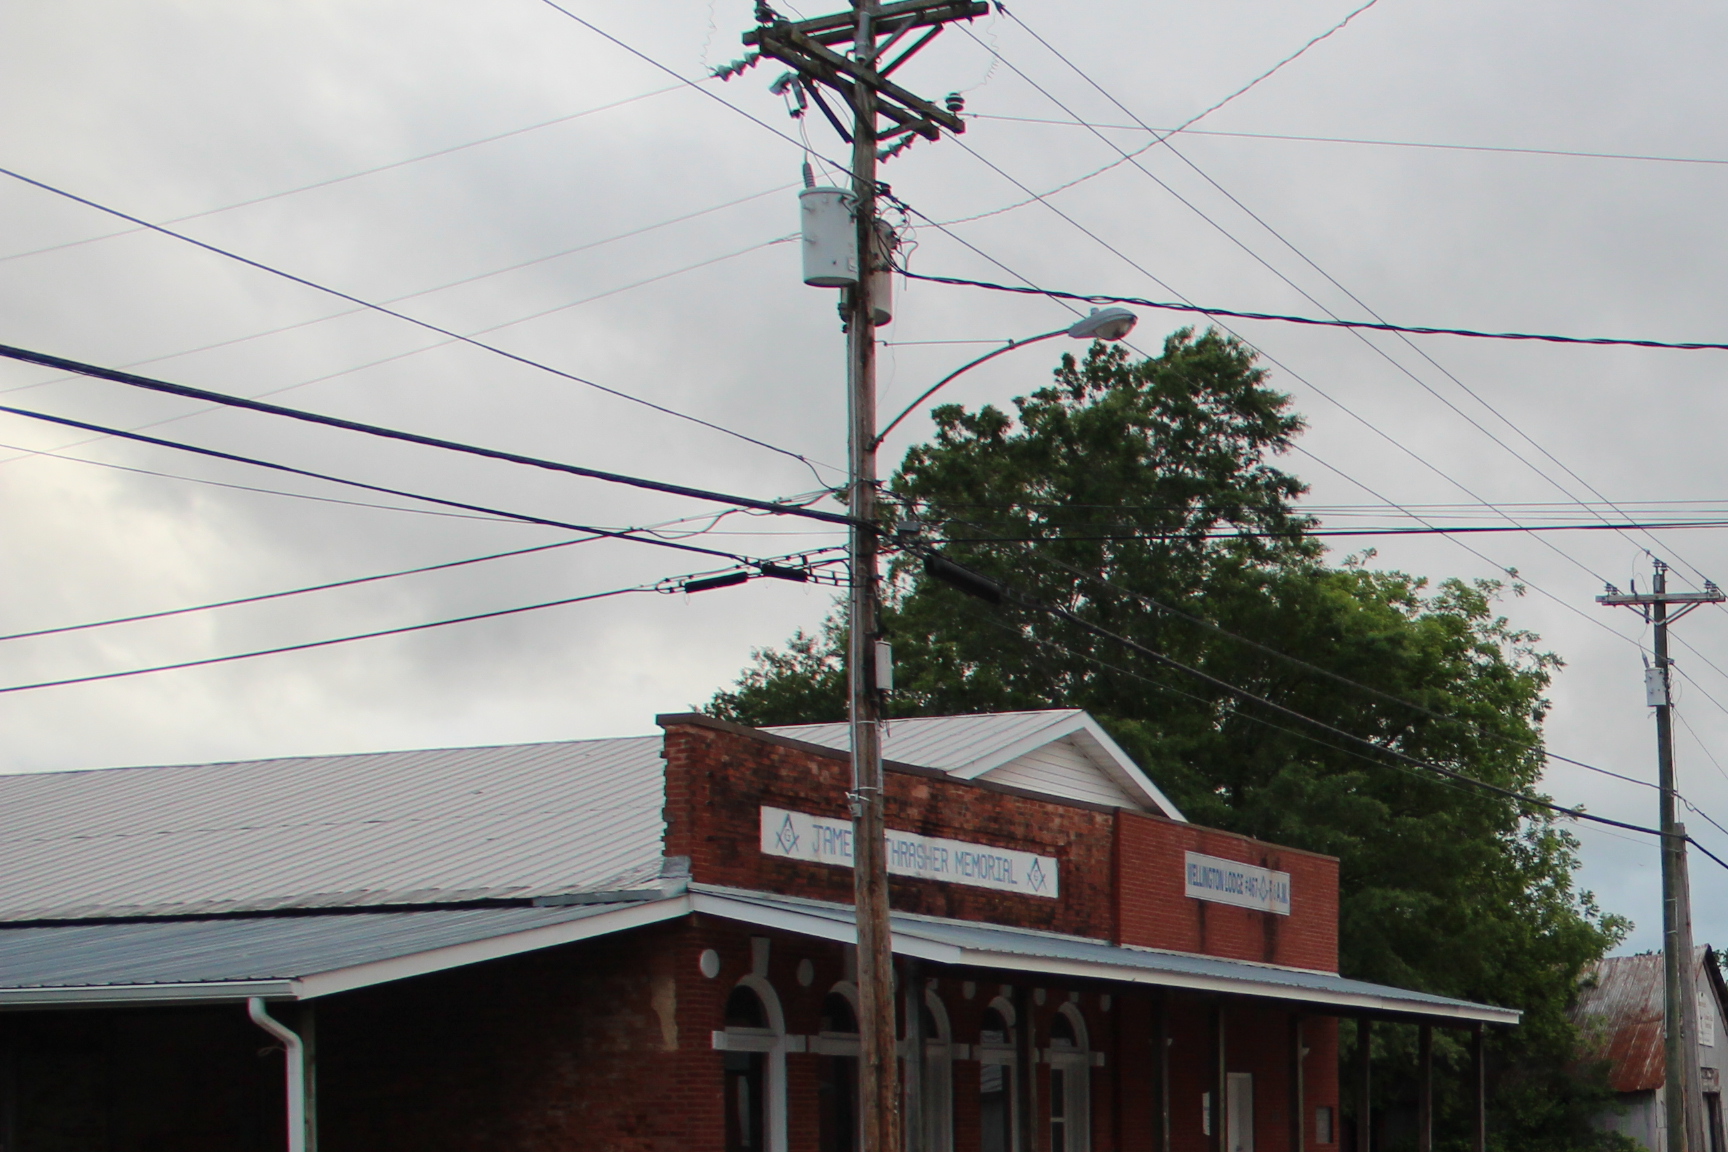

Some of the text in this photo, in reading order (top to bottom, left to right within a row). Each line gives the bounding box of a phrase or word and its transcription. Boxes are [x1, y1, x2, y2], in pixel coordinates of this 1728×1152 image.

[812, 824, 1018, 885] JAME THRASHER MEMORIAL
